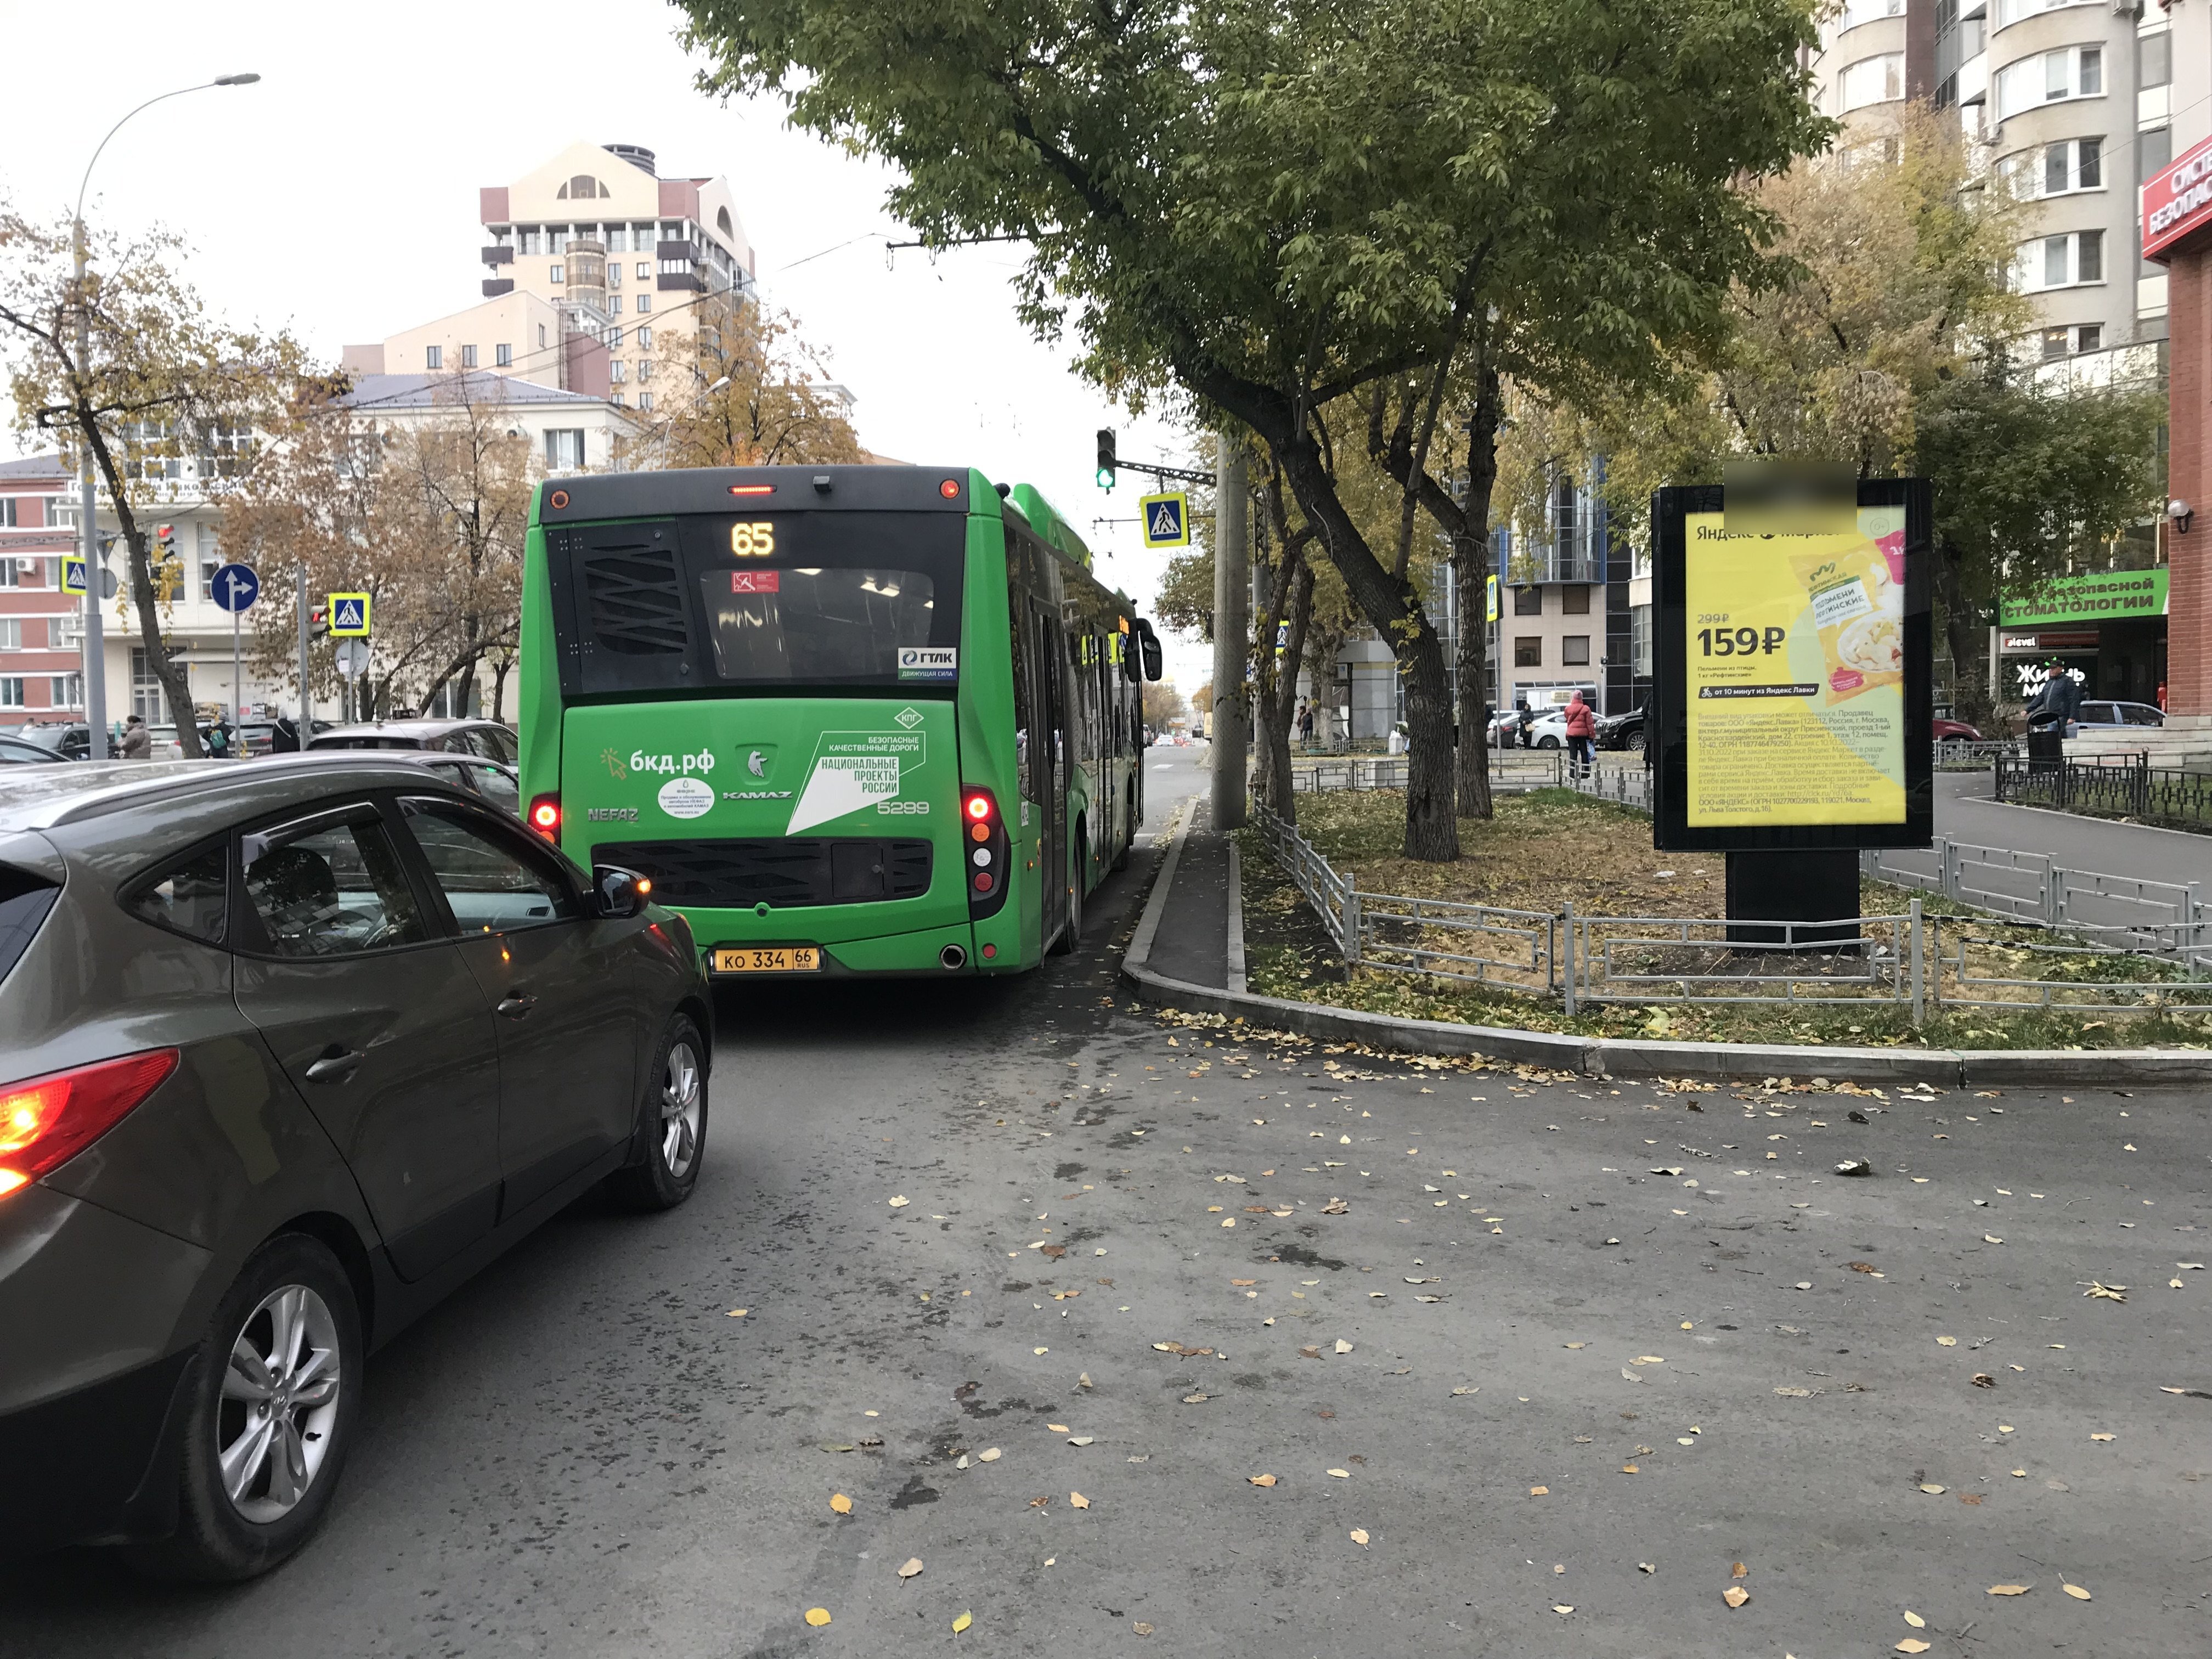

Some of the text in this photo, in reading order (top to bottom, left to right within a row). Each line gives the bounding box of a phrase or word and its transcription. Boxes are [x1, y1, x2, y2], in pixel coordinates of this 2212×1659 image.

[731, 523, 773, 555] 65
[2005, 595, 2153, 618] СТОМАТОЛОГИИ
[921, 653, 952, 663] ГТЛК
[2016, 664, 2085, 683] Жиь
[1766, 687, 1792, 695] Яндекс
[630, 748, 714, 775] бкд.рф
[822, 759, 896, 770] НАЦИОНАЛЬНЫЕ
[854, 770, 896, 781] ПРОЕКТЫ
[862, 782, 896, 793] РОССИИ
[723, 791, 792, 799] KAMAZ
[878, 802, 929, 814] 5299
[588, 808, 639, 821] NEFAZ
[725, 950, 811, 968] КО 334 66
